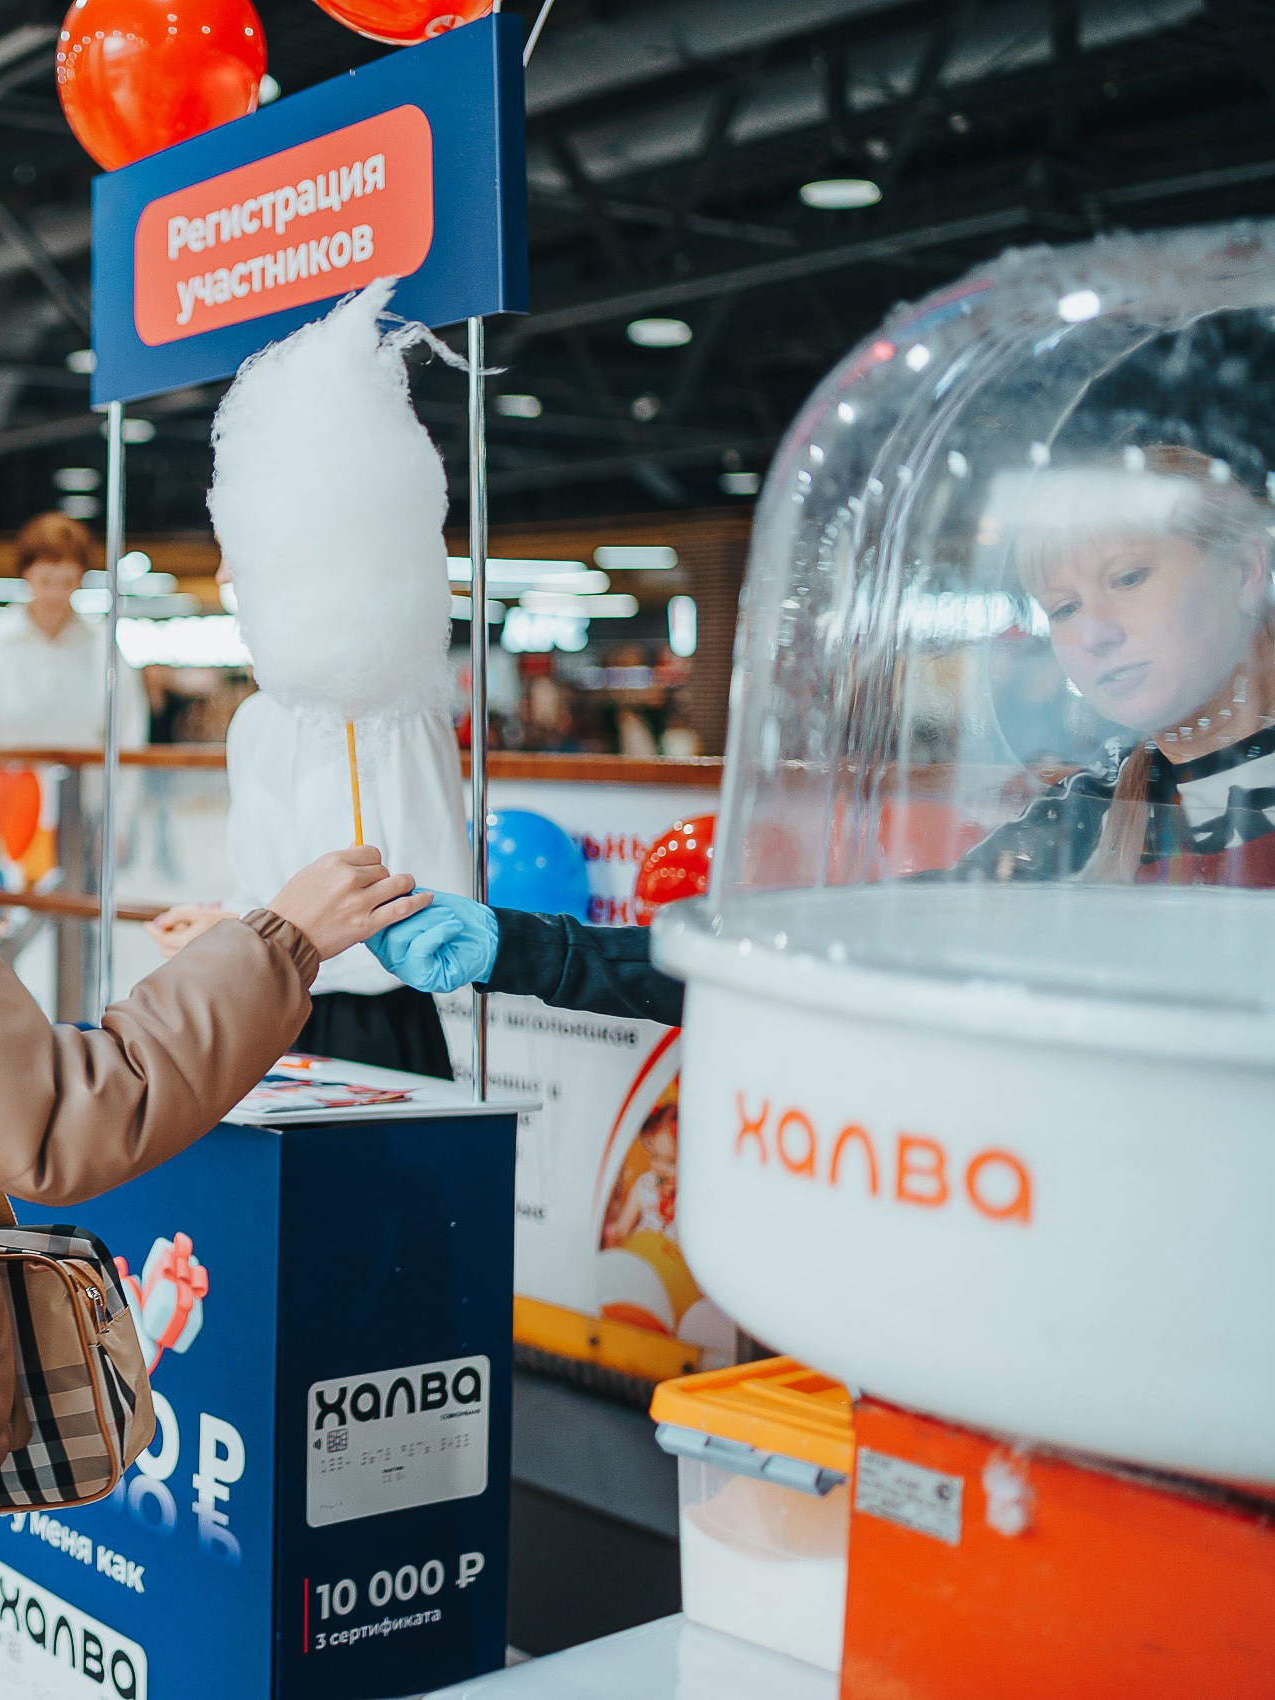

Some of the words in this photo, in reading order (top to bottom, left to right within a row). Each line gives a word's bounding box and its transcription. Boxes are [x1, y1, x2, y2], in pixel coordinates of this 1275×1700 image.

[167, 152, 386, 261] Регистрация
[175, 223, 375, 326] участников
[29, 1510, 93, 1565] меня
[96, 1544, 146, 1594] как
[315, 1578, 358, 1620] 10
[367, 1559, 446, 1608] 000
[454, 1551, 486, 1589] ₽
[314, 1632, 327, 1650] 3
[328, 1608, 443, 1645] сертификата
